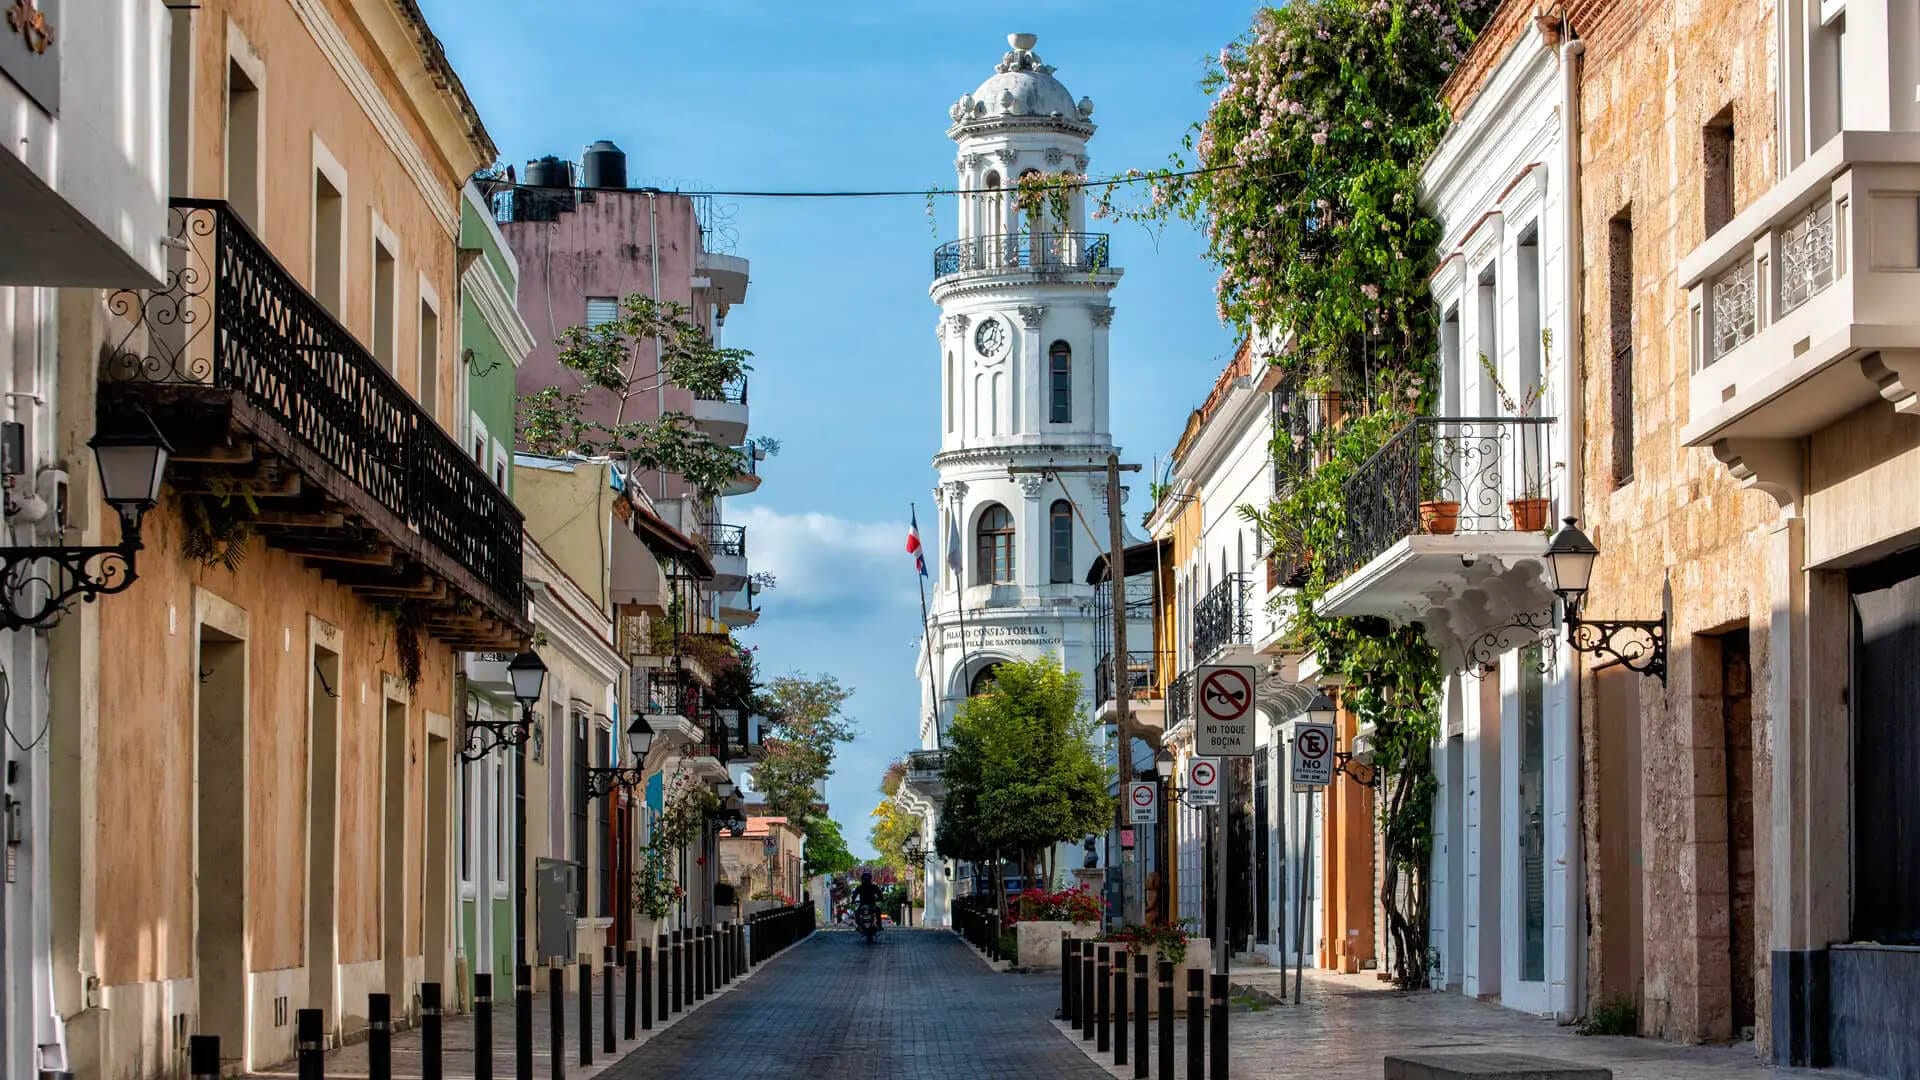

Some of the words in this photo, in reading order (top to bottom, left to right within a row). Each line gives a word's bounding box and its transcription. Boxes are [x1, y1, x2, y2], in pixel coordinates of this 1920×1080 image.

[946, 630, 971, 640] PALACO
[996, 639, 1020, 647] SANTO
[1021, 638, 1060, 646] DOMINGO
[1206, 725, 1217, 734] NO
[1220, 725, 1246, 735] TOQUE
[1211, 737, 1240, 746] BOCINA
[1302, 759, 1321, 769] NO
